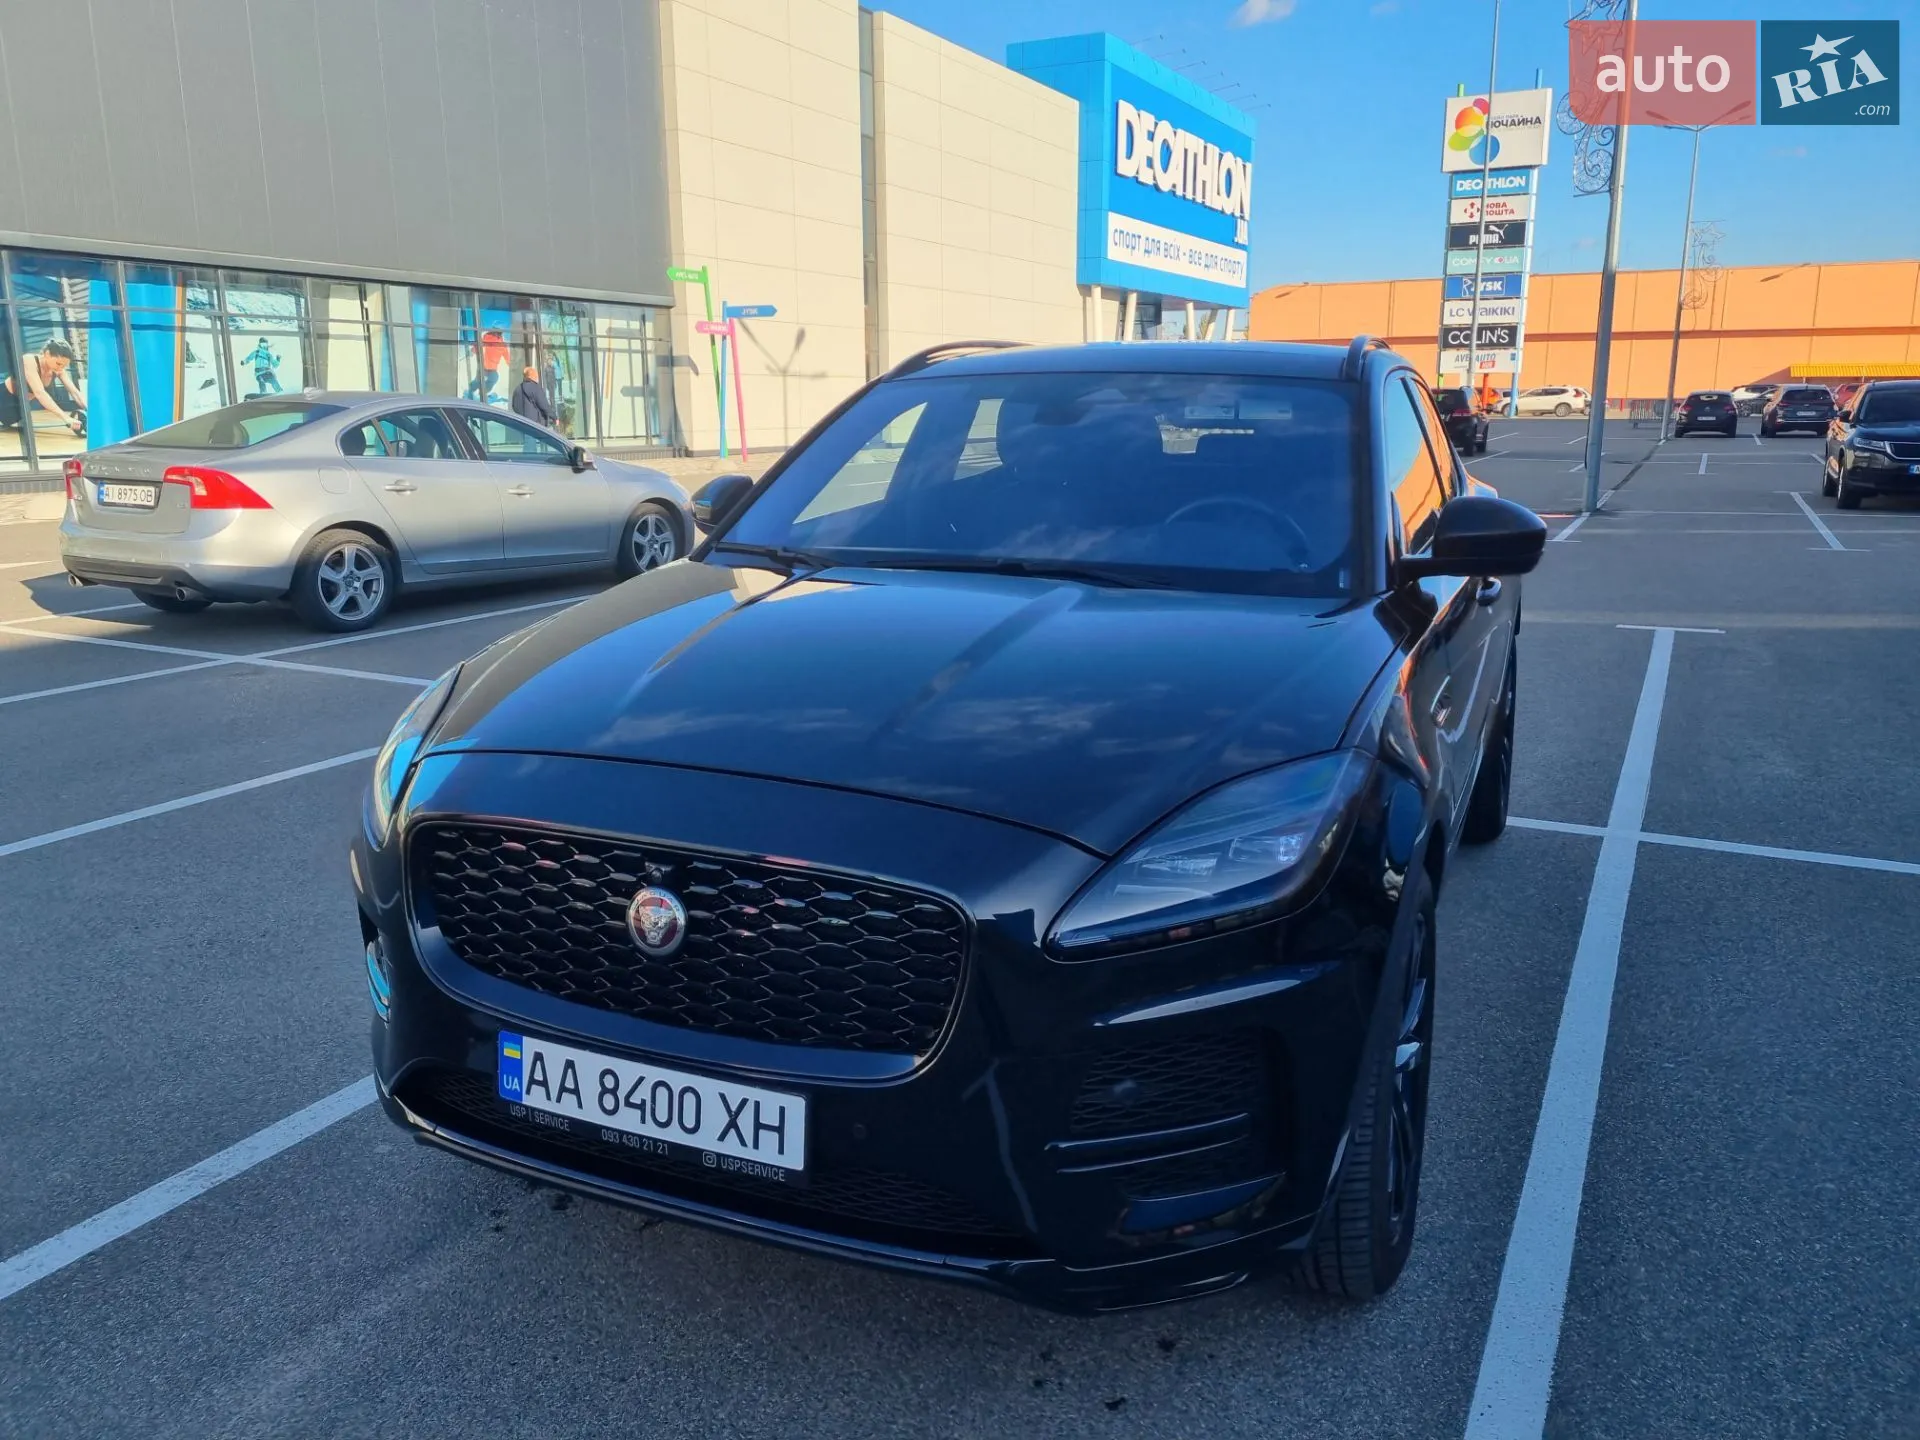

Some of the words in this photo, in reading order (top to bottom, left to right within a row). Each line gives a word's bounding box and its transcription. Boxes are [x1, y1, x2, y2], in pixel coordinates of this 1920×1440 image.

[1116, 99, 1252, 221] DECATHLON
[1456, 176, 1526, 191] DECTHLON
[1113, 227, 1142, 256] спорт
[1144, 236, 1161, 258] для
[1163, 238, 1181, 262] всіх
[1188, 248, 1203, 267] все
[1204, 252, 1218, 271] для
[1219, 257, 1245, 280] спорту
[1452, 256, 1493, 266] COMY
[1449, 307, 1465, 318] LC
[117, 487, 138, 502] 8975
[503, 1075, 521, 1093] UA
[525, 1050, 584, 1110] AA
[597, 1068, 702, 1135] 8400
[716, 1091, 786, 1156] XH
[510, 1103, 527, 1119] USP
[534, 1112, 571, 1132] SERVICE
[601, 1128, 620, 1144] 093
[622, 1135, 640, 1149] 430
[642, 1139, 654, 1153] 21
[657, 1142, 669, 1156] 21
[720, 1156, 786, 1182] USPSERVICE
